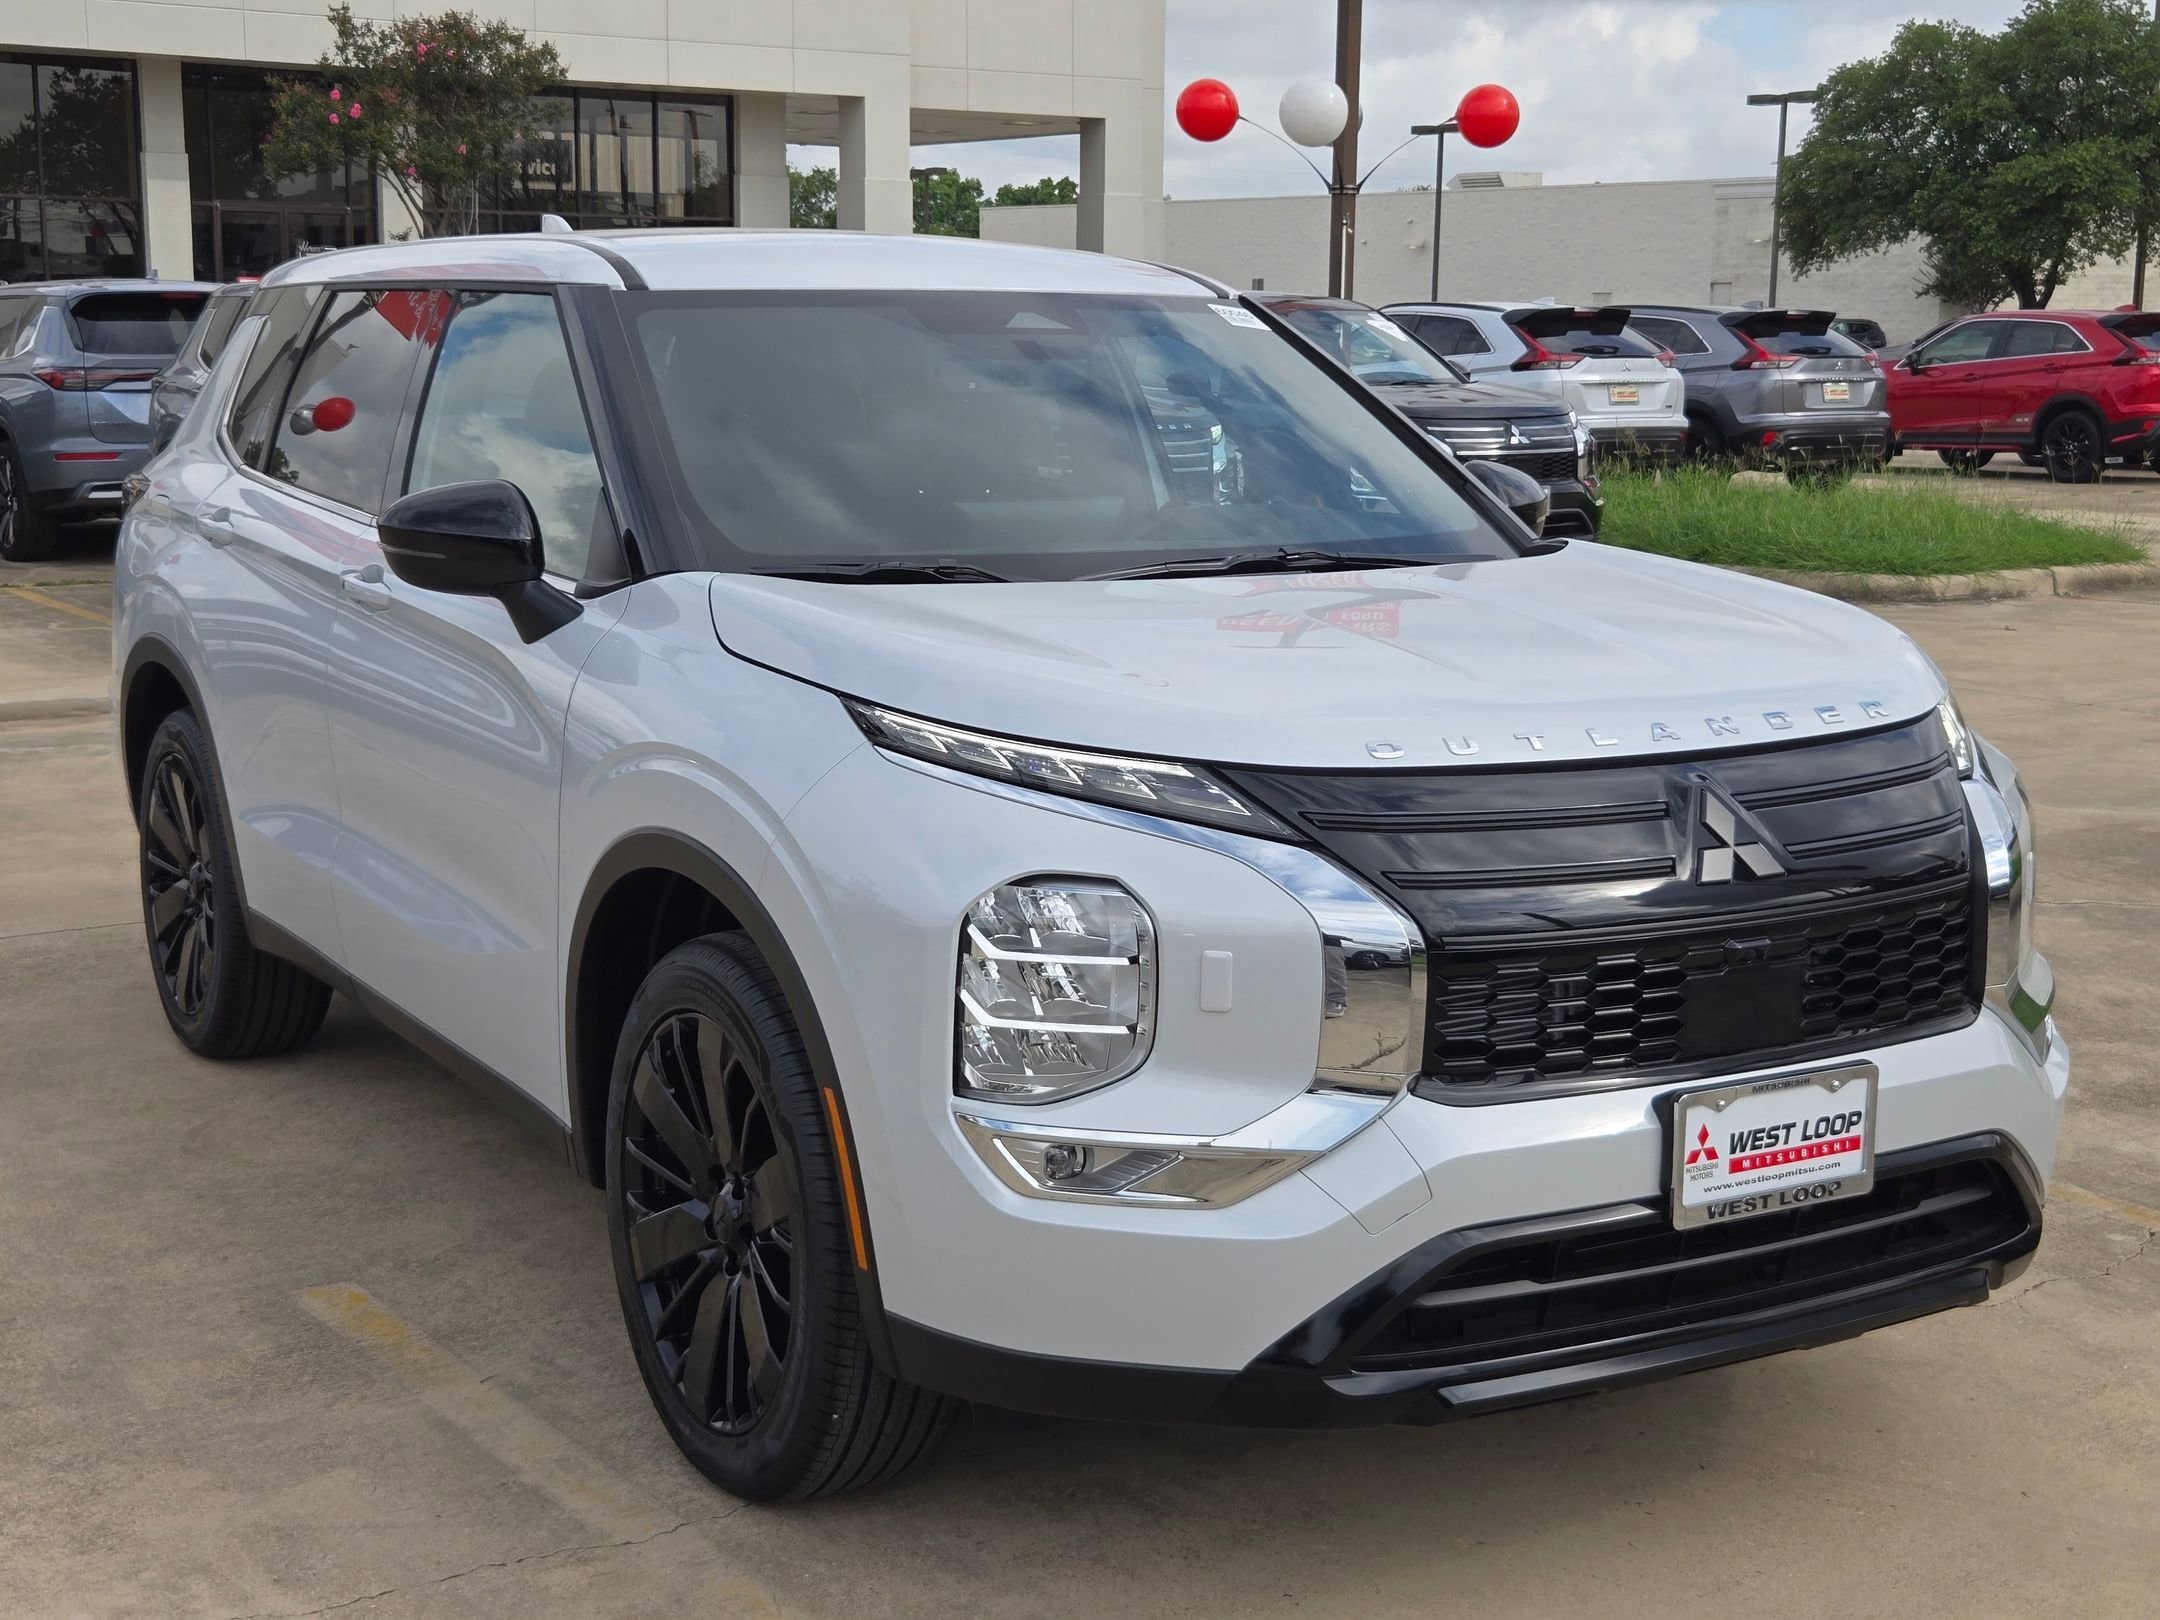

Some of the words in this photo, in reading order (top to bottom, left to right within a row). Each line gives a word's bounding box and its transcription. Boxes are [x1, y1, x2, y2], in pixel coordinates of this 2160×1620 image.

[1365, 700, 1889, 759] OUTLANDER
[1729, 1122, 1797, 1155] WEST
[1801, 1110, 1863, 1141] LOOP
[1685, 1162, 1719, 1175] MITSUBISHI
[1742, 1141, 1849, 1169] MITSUBISHI
[1689, 1171, 1714, 1182] MOTORS
[1703, 1161, 1841, 1193] www.westloopmitsu.com
[1706, 1194, 1772, 1219] WEST
[1779, 1181, 1842, 1205] LOOP
